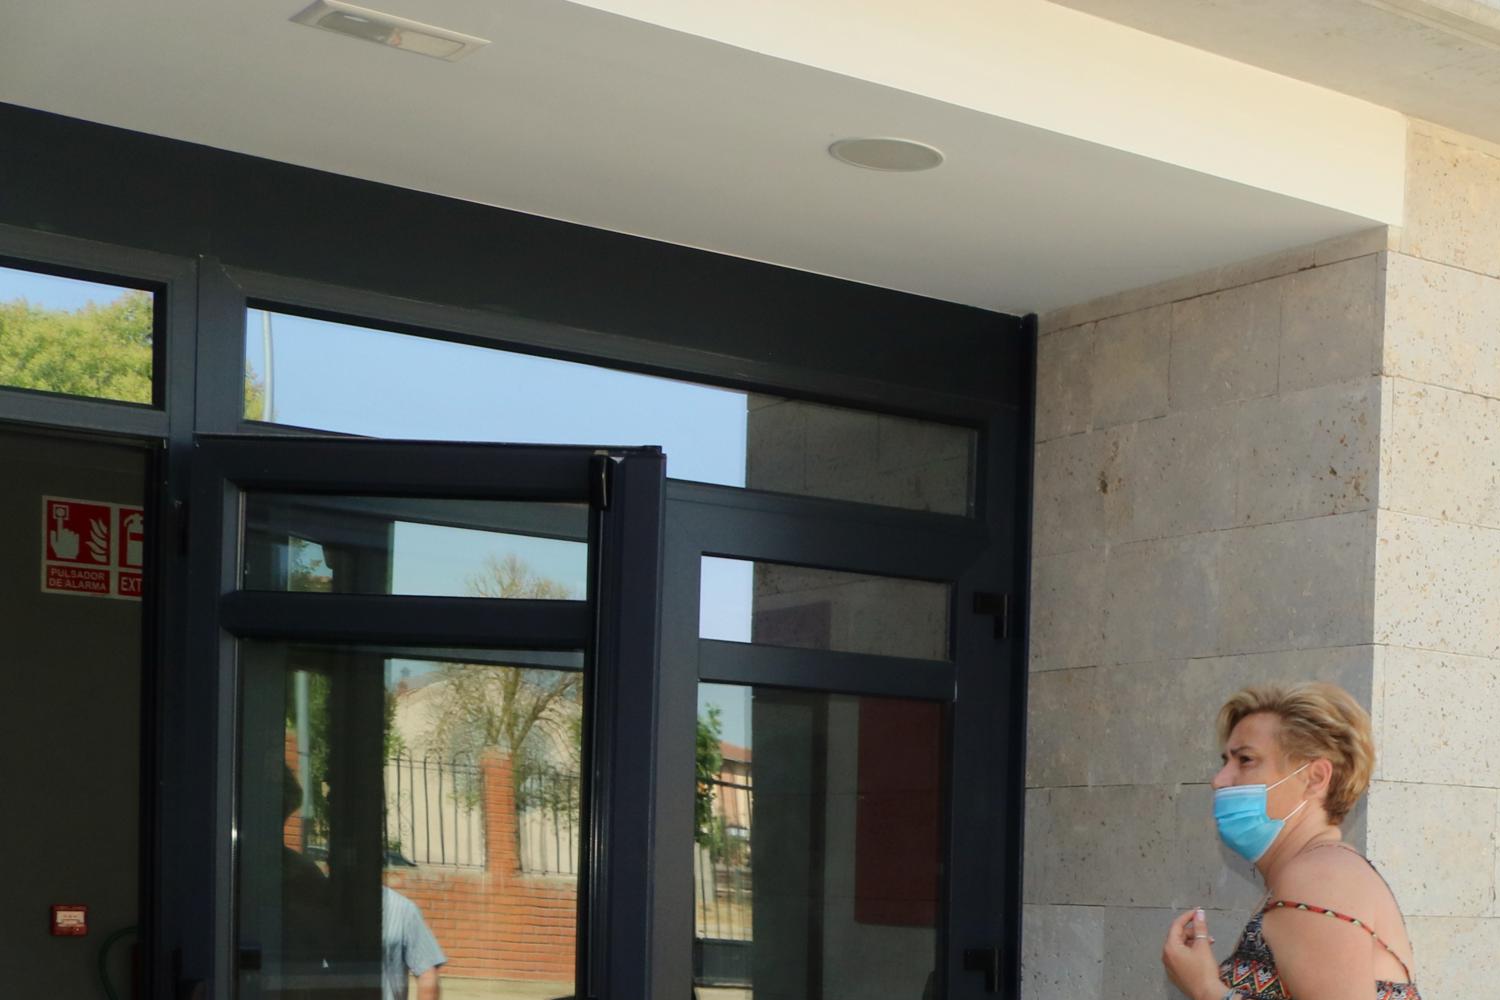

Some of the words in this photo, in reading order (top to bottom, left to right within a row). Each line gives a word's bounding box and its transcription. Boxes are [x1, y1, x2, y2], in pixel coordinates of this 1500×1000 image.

[50, 568, 105, 580] PULSADOR
[48, 578, 63, 587] DE
[64, 580, 107, 591] ALARMA
